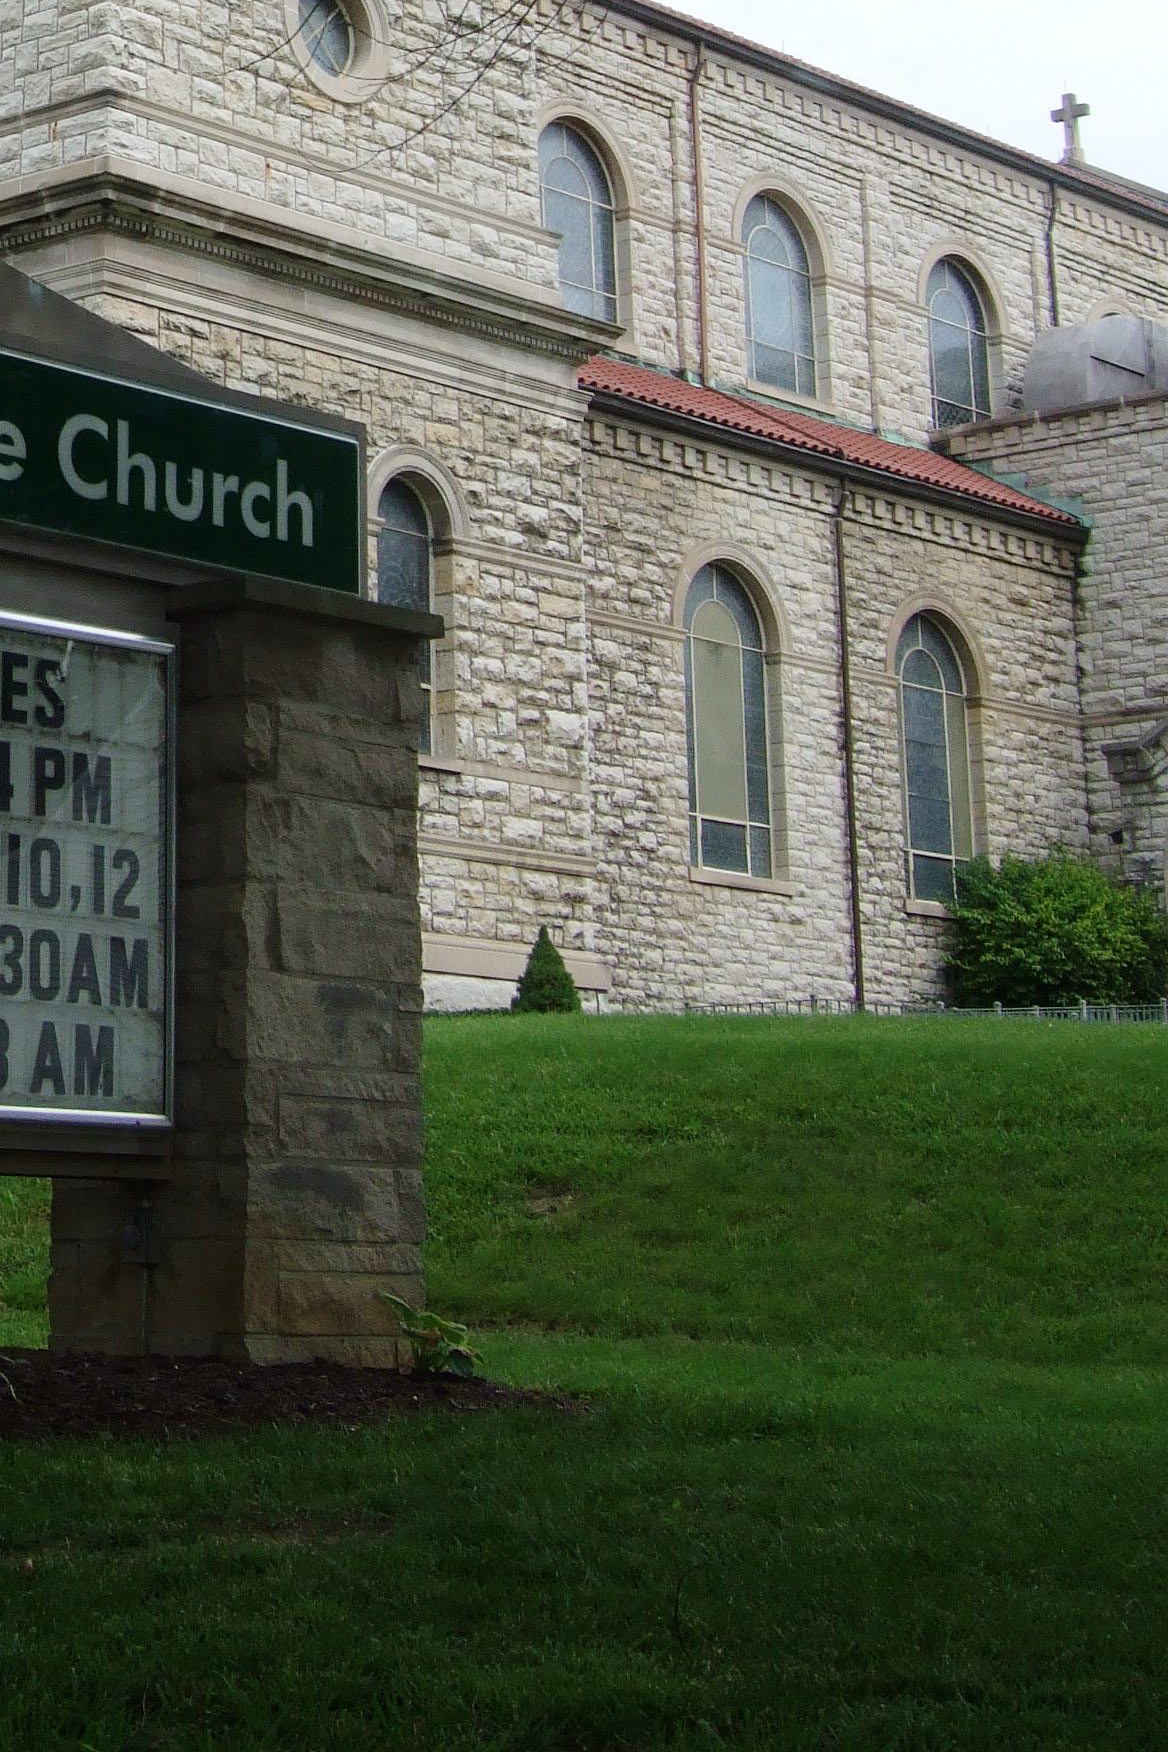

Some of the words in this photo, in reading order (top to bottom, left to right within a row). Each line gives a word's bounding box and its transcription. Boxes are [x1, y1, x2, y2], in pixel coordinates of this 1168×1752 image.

[57, 413, 314, 548] Church
[33, 746, 112, 825] PM
[30, 1021, 114, 1098] AM
